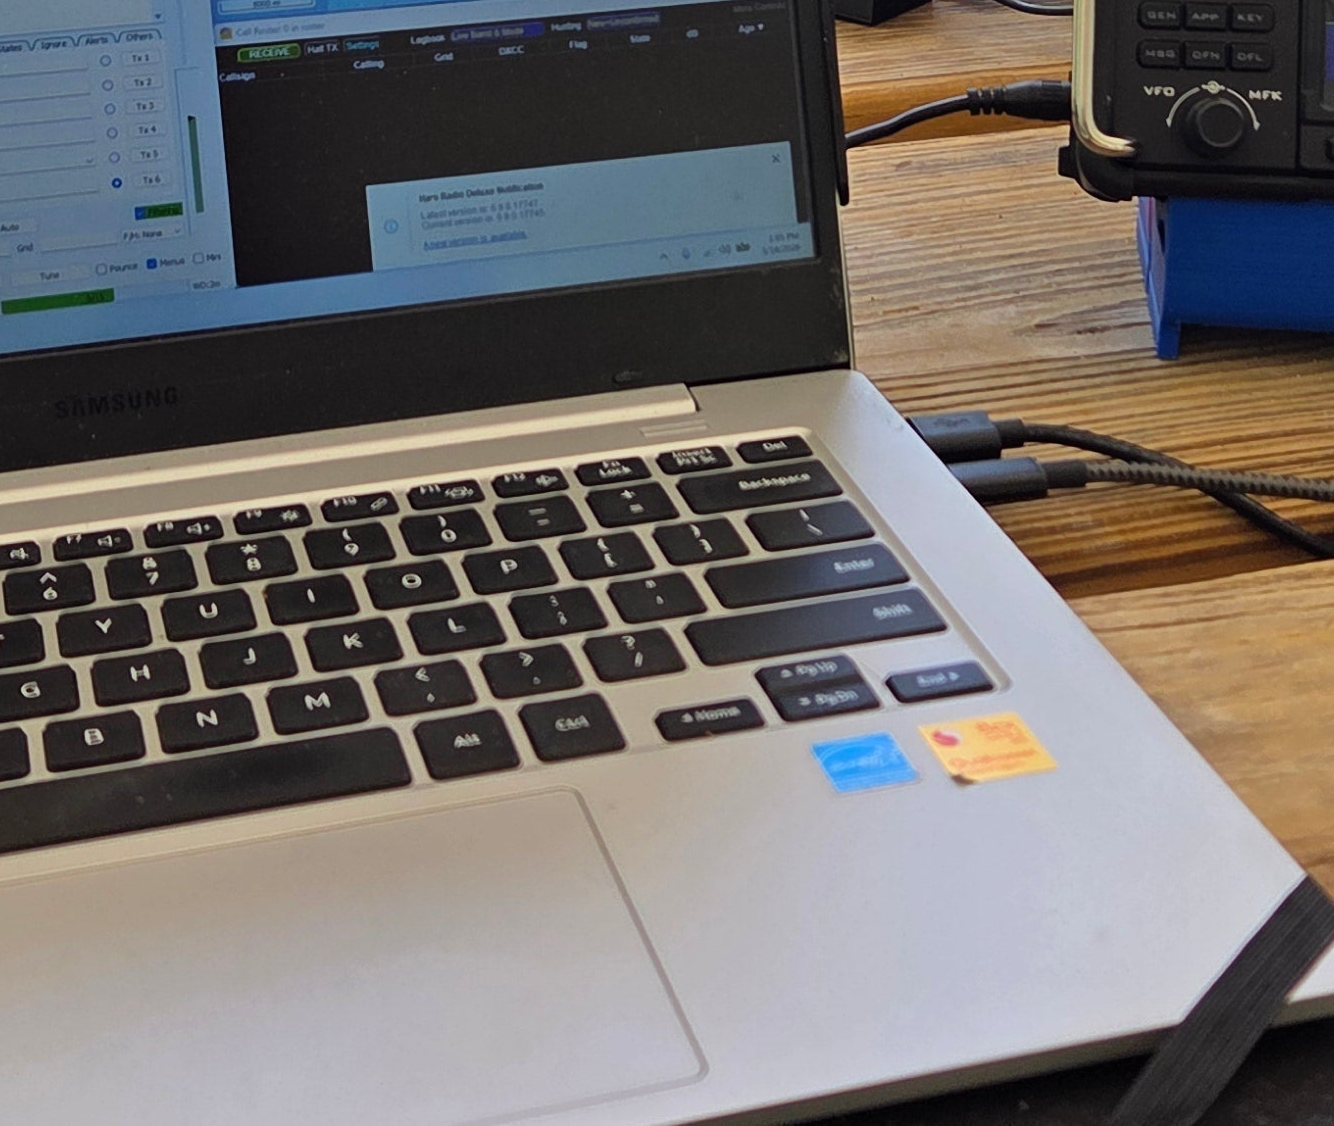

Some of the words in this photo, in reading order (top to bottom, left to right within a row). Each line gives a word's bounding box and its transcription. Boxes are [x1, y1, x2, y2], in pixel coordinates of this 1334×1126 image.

[125, 32, 154, 42] Others
[1144, 86, 1175, 97] VFO
[1249, 90, 1283, 101] MFK
[55, 385, 179, 419] SAMSUNG
[246, 557, 262, 572] 8
[499, 559, 519, 574] P
[833, 556, 875, 574] Enter
[400, 572, 422, 589] O
[43, 585, 58, 600] 6
[199, 602, 219, 619] U
[871, 602, 914, 621] Shift
[95, 618, 113, 635] Y
[447, 617, 466, 633] L
[342, 632, 364, 649] K
[242, 647, 258, 665] J
[130, 664, 151, 682] H
[20, 682, 41, 699] G
[304, 692, 331, 711] M
[196, 709, 219, 727] N
[83, 727, 105, 746] B
